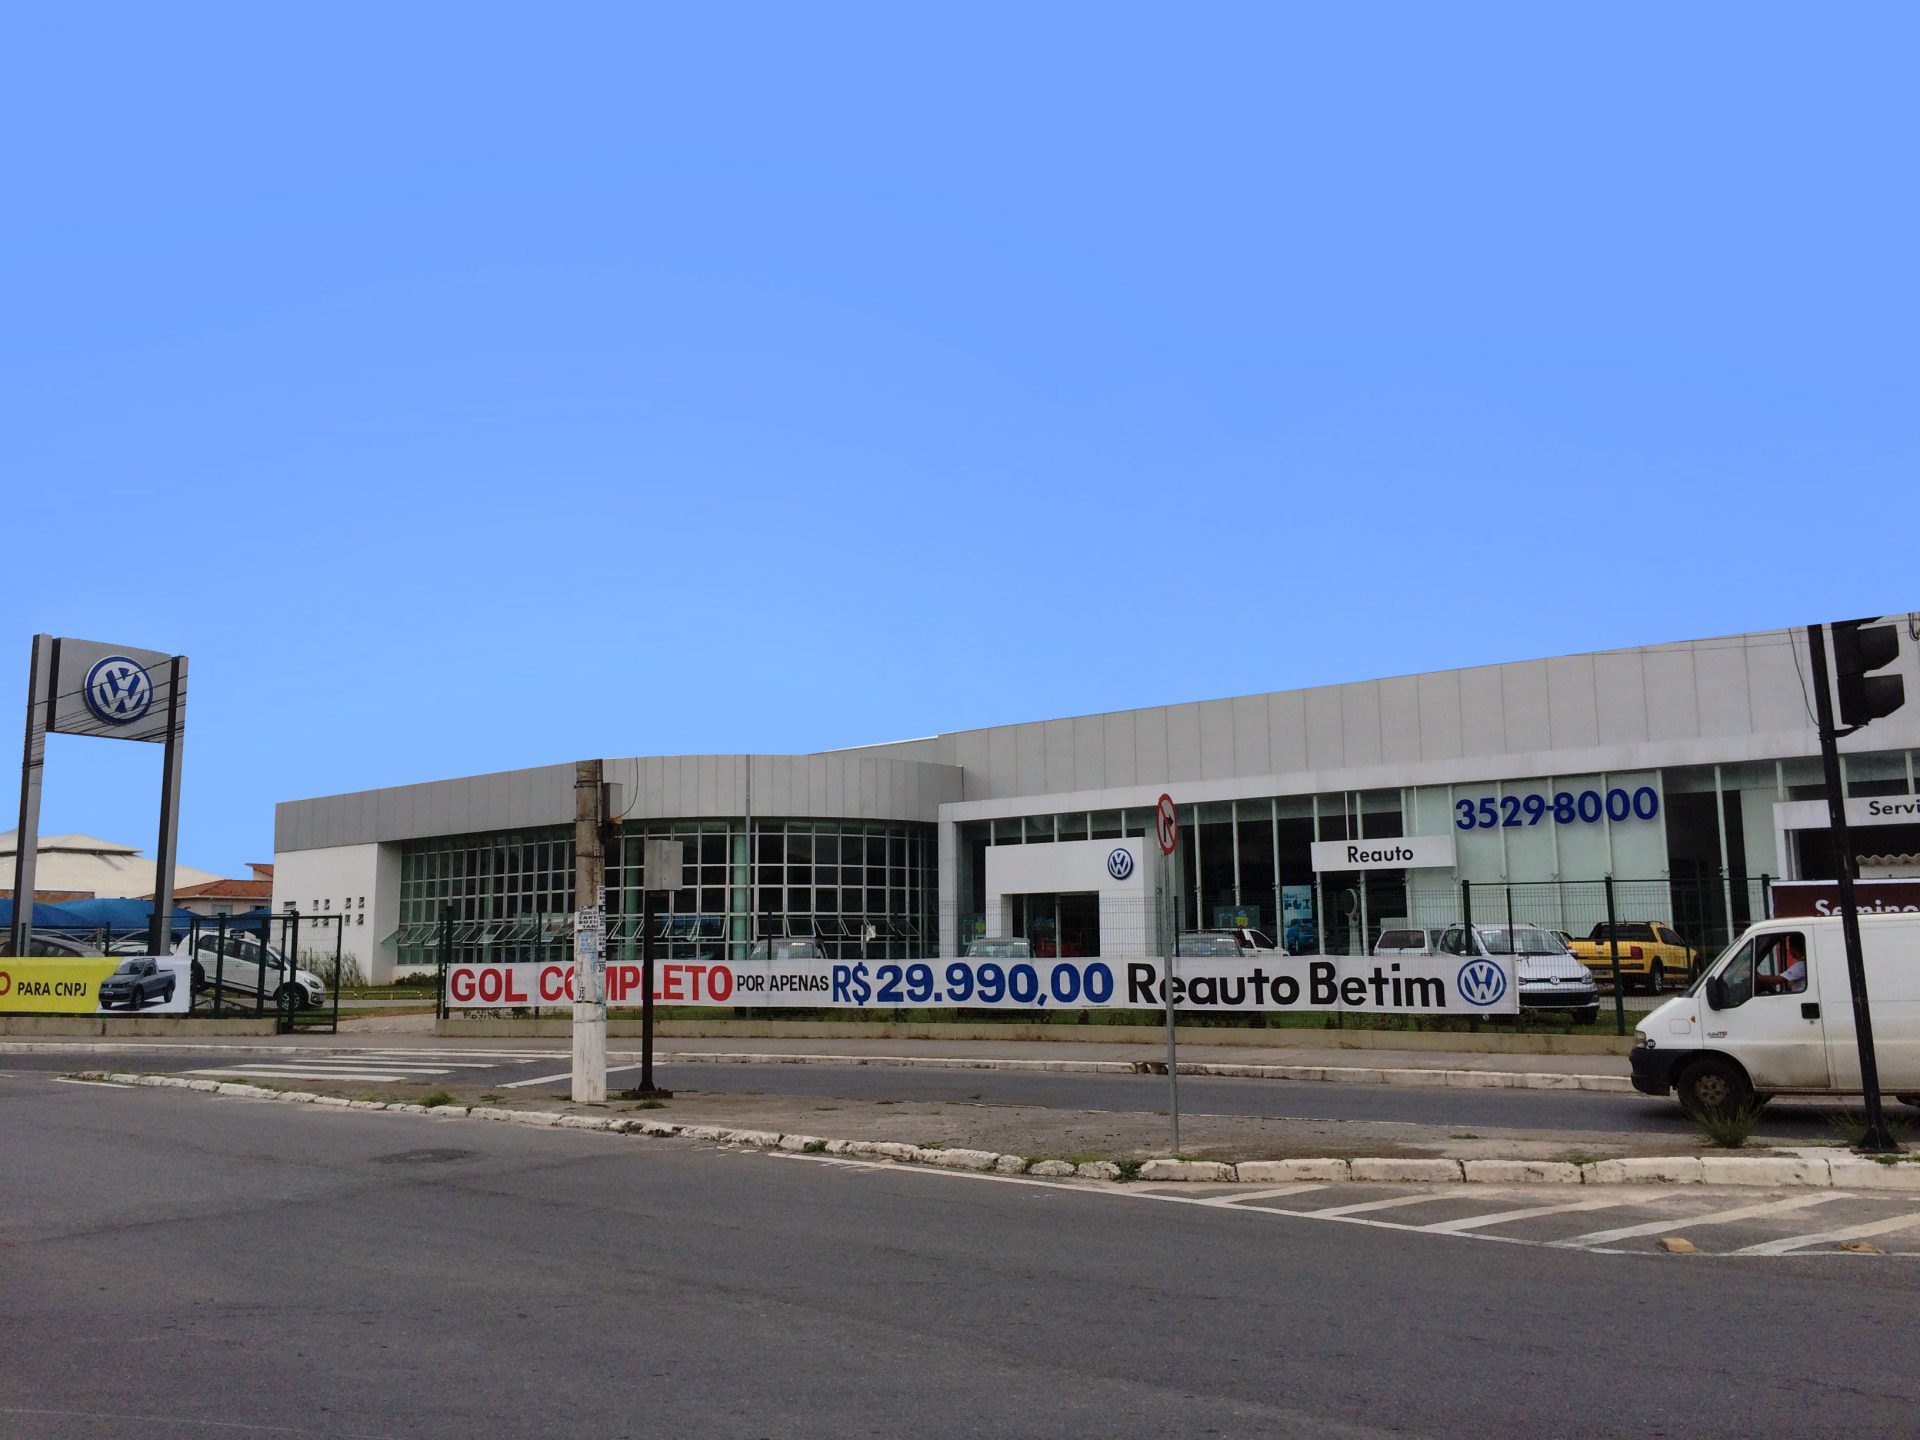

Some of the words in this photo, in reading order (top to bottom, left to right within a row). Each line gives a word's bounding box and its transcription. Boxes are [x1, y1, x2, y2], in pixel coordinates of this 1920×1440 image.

[1456, 787, 1657, 830] 3529-8000
[1869, 799, 1920, 816] Servi
[1347, 845, 1414, 864] Reauto
[1815, 899, 1919, 916] Sino
[17, 982, 51, 996] PARA
[55, 983, 87, 997] CNPJ
[451, 968, 528, 1002] GOL
[539, 965, 733, 1002] CPETO
[736, 975, 765, 992] POR
[769, 975, 830, 992] APENAS
[1127, 963, 1300, 1006] Reauto
[1309, 962, 1447, 1007] Betim
